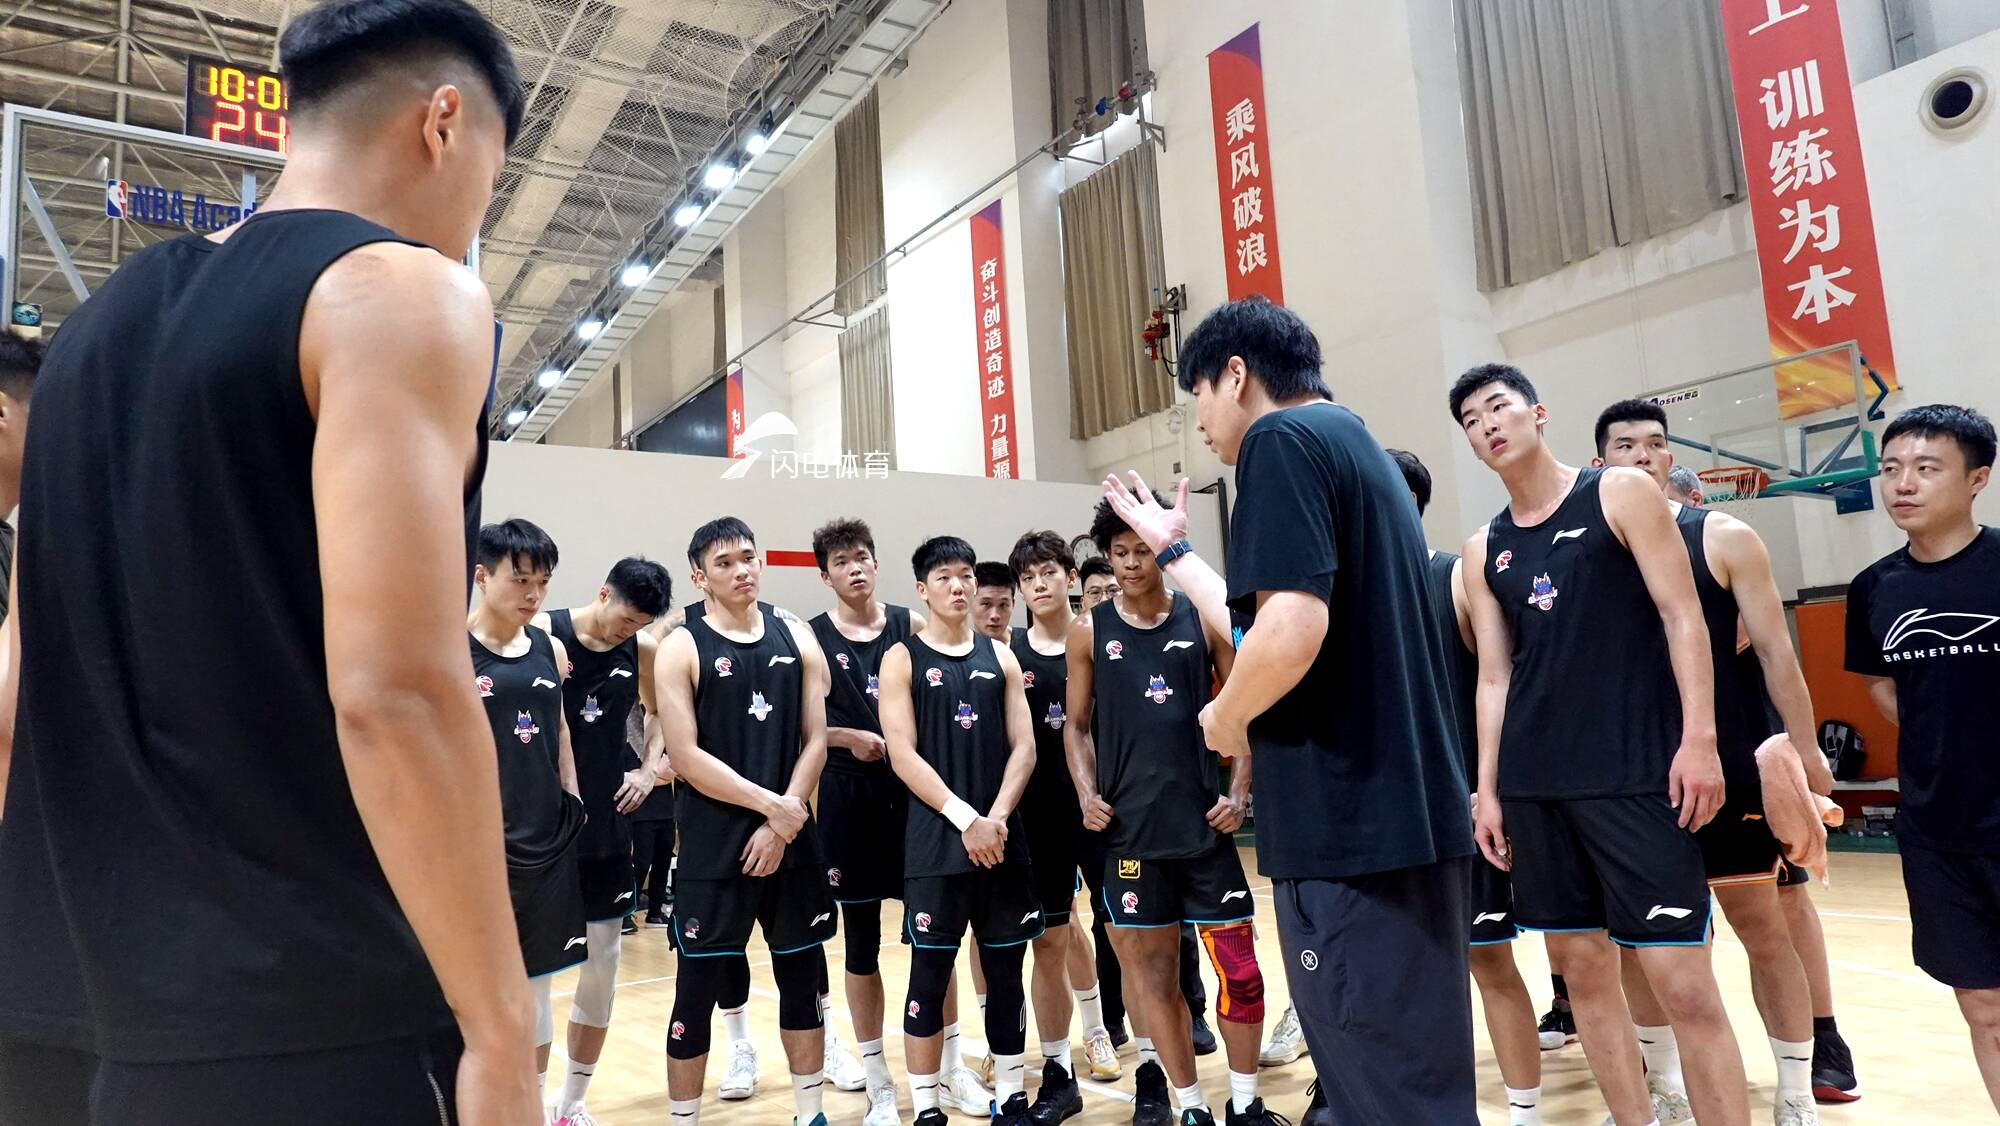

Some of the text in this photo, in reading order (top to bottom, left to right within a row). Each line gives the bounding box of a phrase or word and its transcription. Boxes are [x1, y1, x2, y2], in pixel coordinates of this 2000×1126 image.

[209, 66, 288, 110] 10:0
[212, 101, 286, 152] 24
[132, 184, 185, 225] NBA
[1225, 98, 1268, 277] 乘风破浪
[1759, 59, 1857, 324] 训练为本
[980, 257, 1006, 400] 奋斗创造奇迹
[1883, 643, 2000, 662] BASKETBALL
